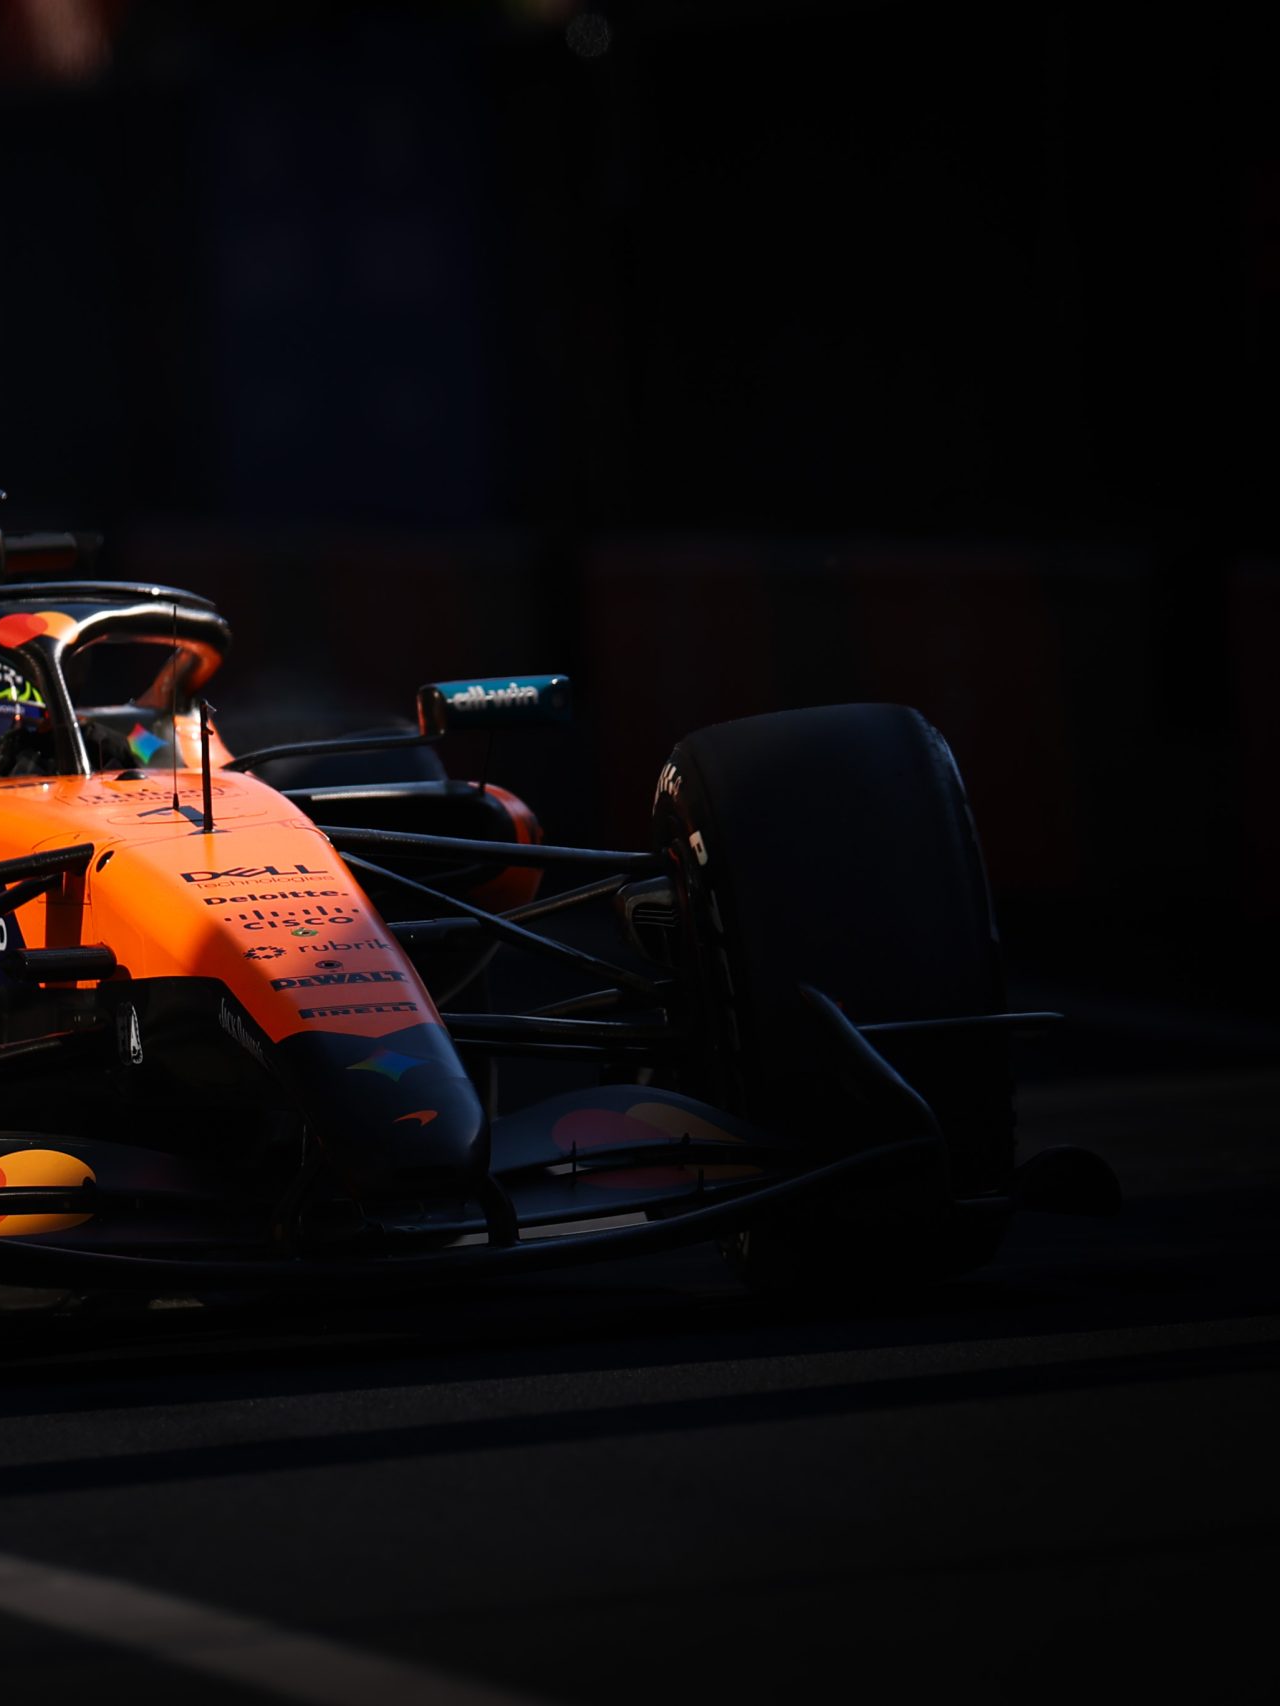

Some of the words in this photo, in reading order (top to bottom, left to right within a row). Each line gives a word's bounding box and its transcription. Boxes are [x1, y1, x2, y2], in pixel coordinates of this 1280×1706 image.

[181, 864, 328, 883] DELL
[203, 890, 349, 906] Deloitte.
[299, 938, 392, 953] rubrik
[299, 1002, 418, 1019] PIRELLI
